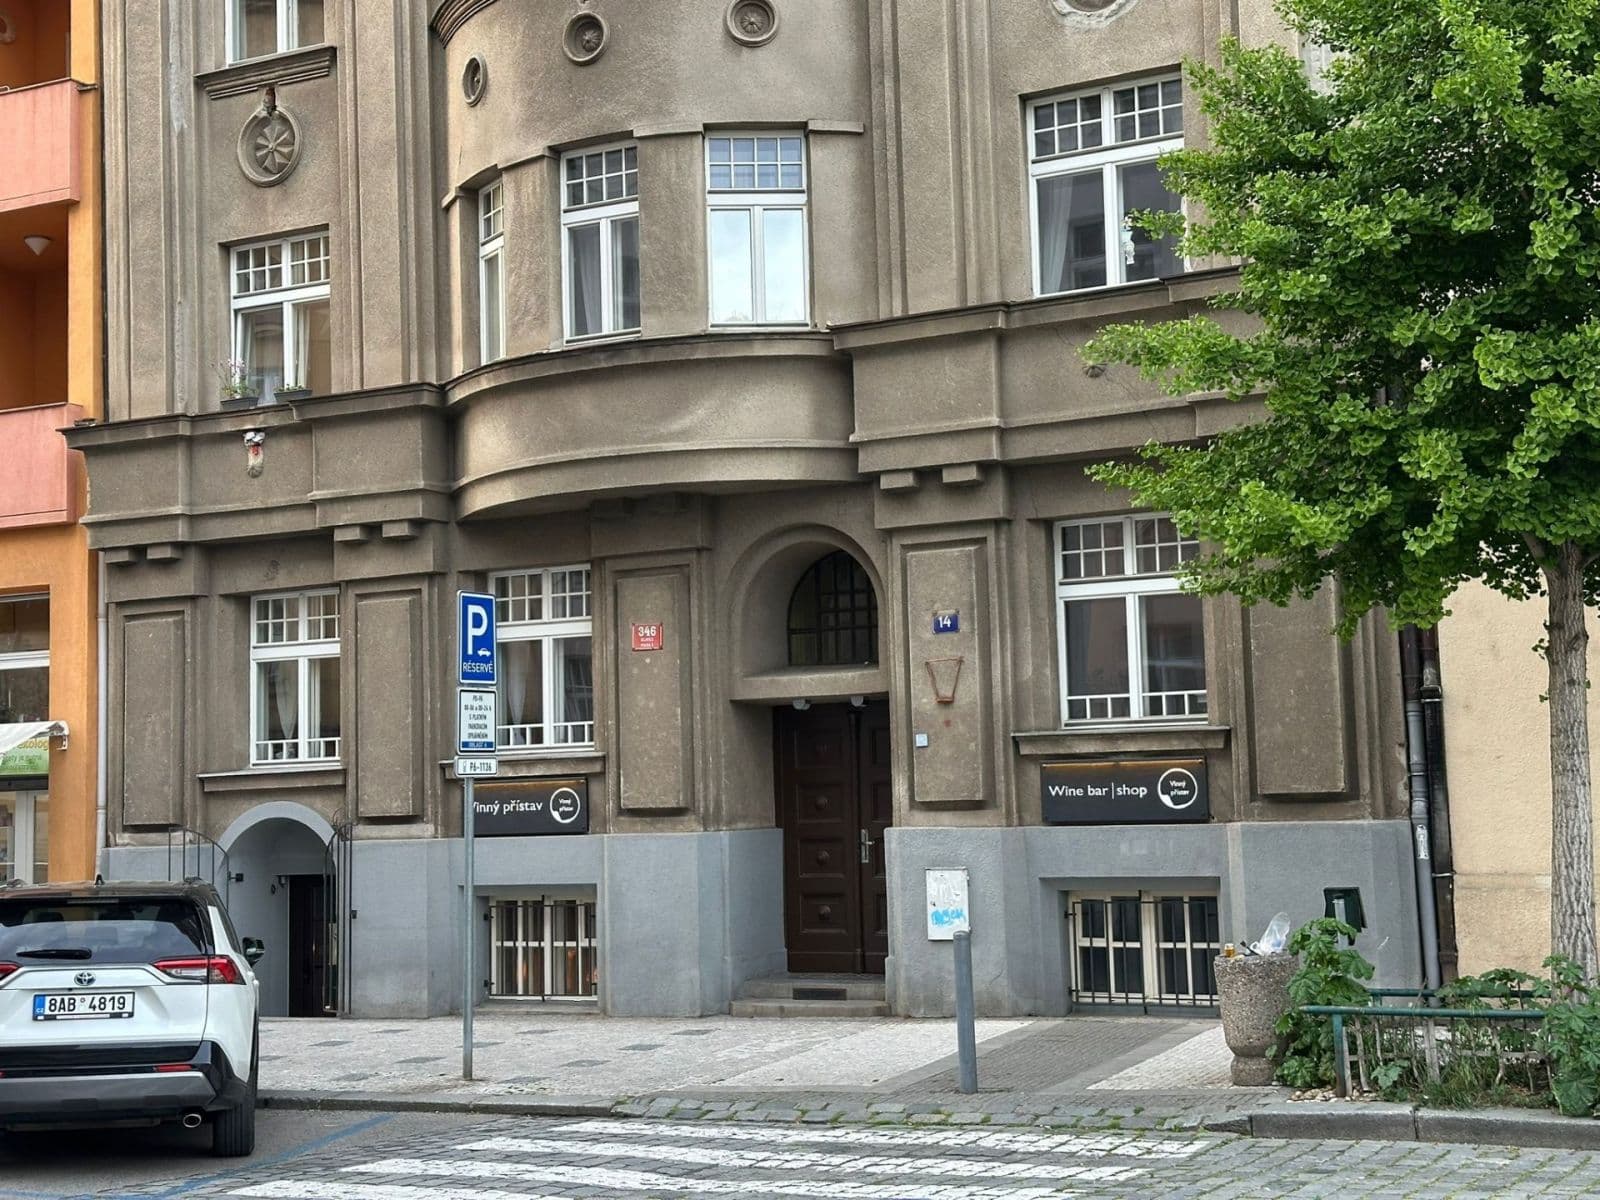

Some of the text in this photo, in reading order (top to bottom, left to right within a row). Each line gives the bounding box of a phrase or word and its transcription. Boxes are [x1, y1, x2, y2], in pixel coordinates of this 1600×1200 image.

[938, 615, 951, 628] 14
[467, 604, 488, 655] P
[638, 625, 657, 637] 346
[462, 660, 494, 673] RÉSERVÉ
[1049, 785, 1084, 797] Wine
[1087, 784, 1108, 796] bar
[1116, 784, 1148, 799] shop
[503, 799, 543, 815] přístav
[48, 995, 126, 1013] 8AB 4819
